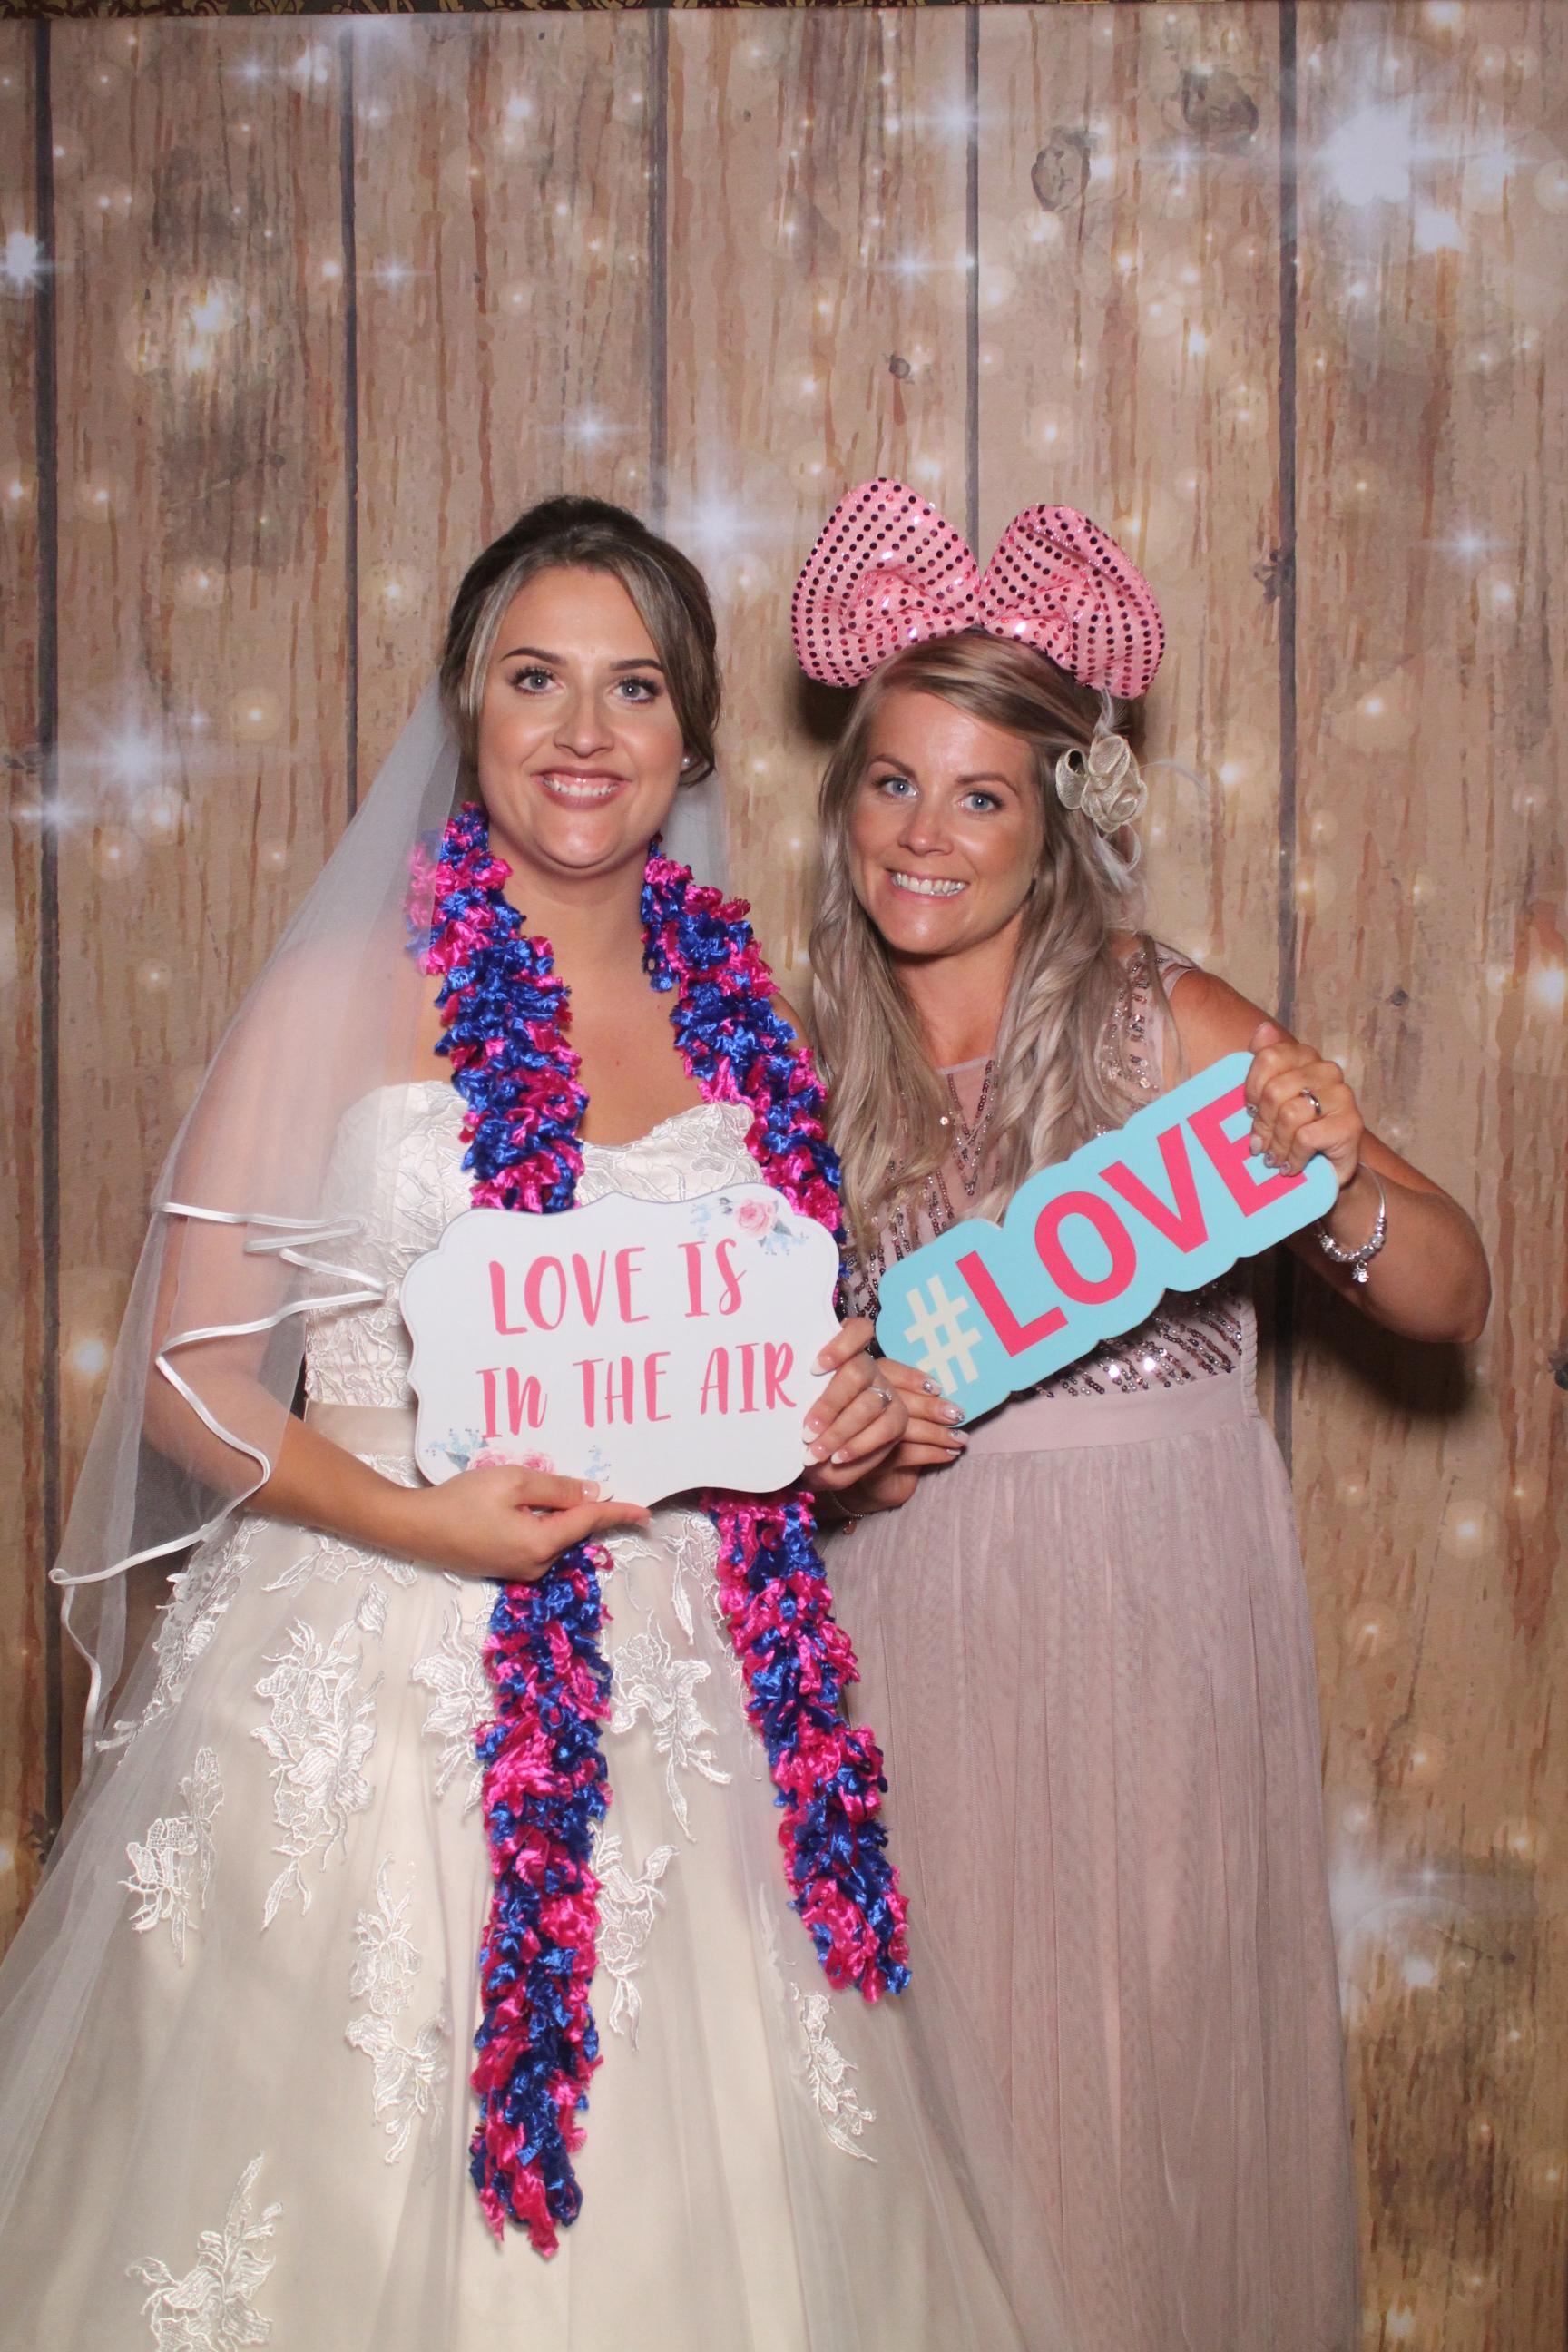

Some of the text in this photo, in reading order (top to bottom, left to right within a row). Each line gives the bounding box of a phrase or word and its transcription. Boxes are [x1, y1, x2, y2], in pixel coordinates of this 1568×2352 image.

[488, 1238, 747, 1335] LOVE IS
[904, 1083, 1308, 1396] #LOVE
[573, 1351, 671, 1428] THE
[700, 1341, 797, 1416] AIR
